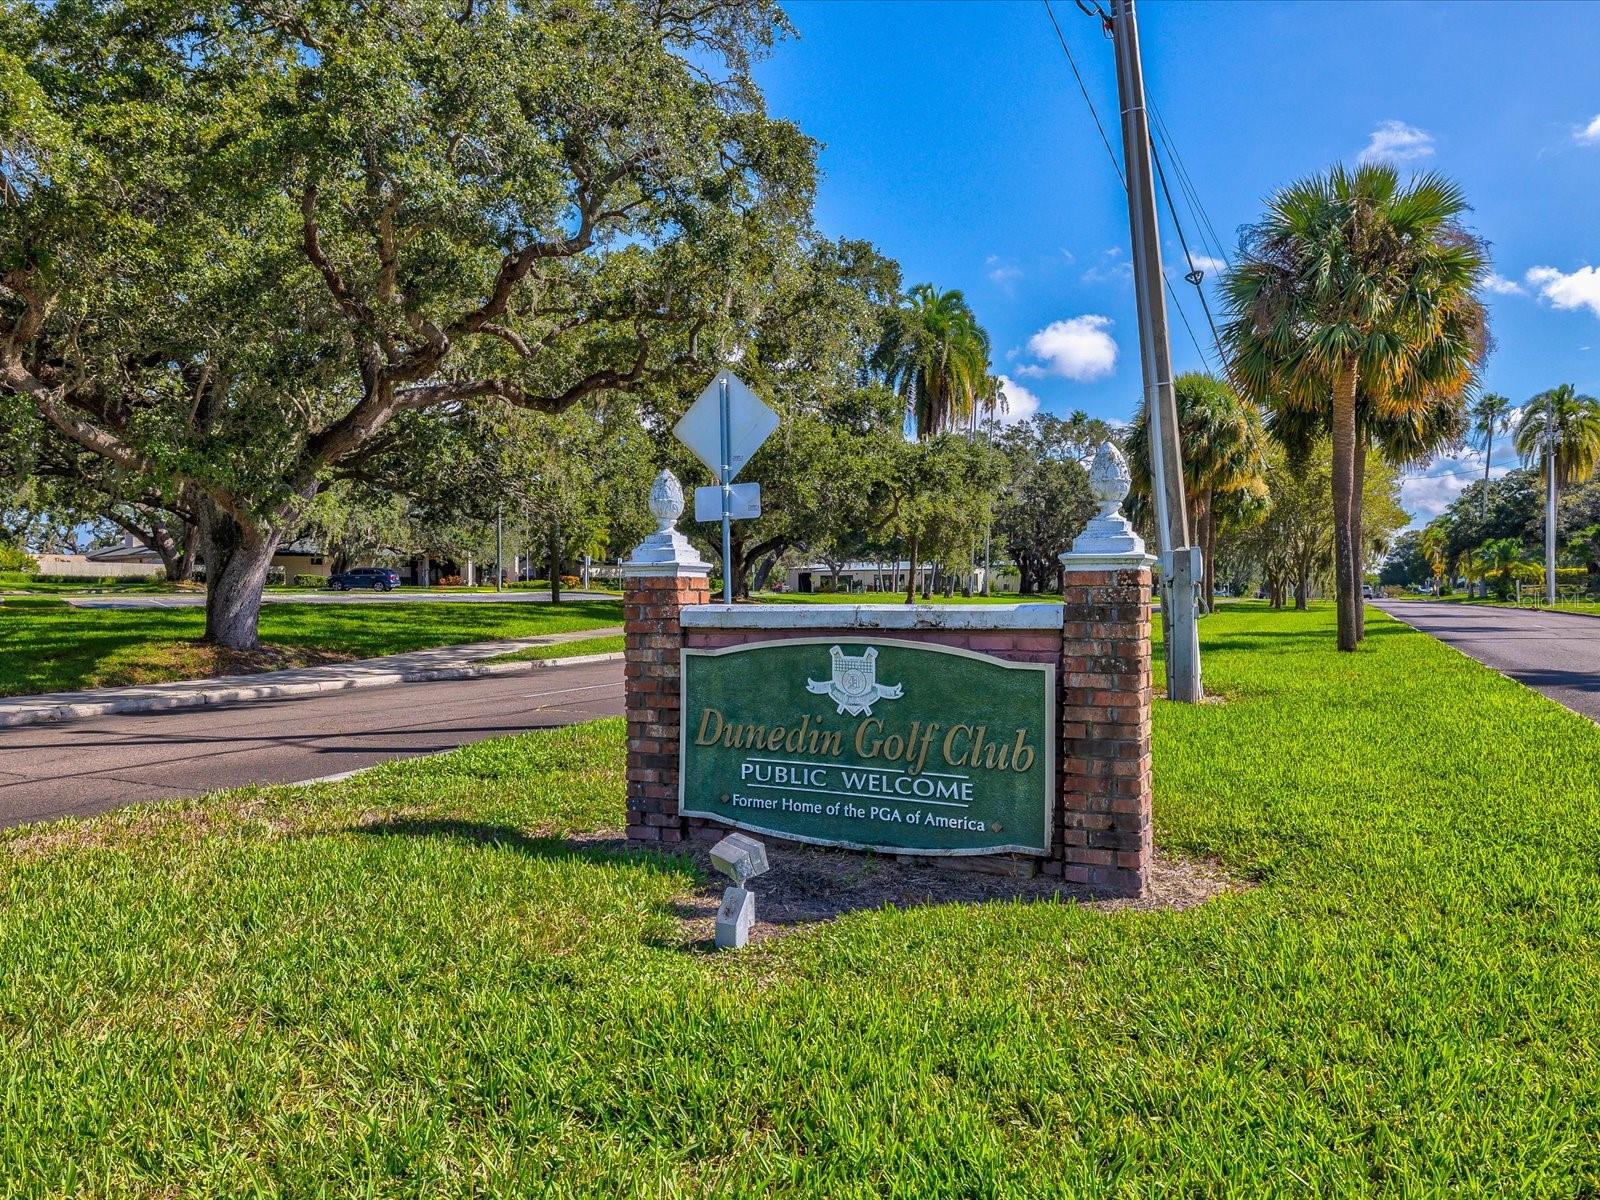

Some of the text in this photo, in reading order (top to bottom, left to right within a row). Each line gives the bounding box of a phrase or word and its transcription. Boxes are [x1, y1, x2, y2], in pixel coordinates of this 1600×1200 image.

[694, 708, 1036, 776] Dunedin Golf Club
[740, 763, 974, 801] PUBLIC WELCOME
[732, 794, 986, 833] Former Home of the PGA of America
